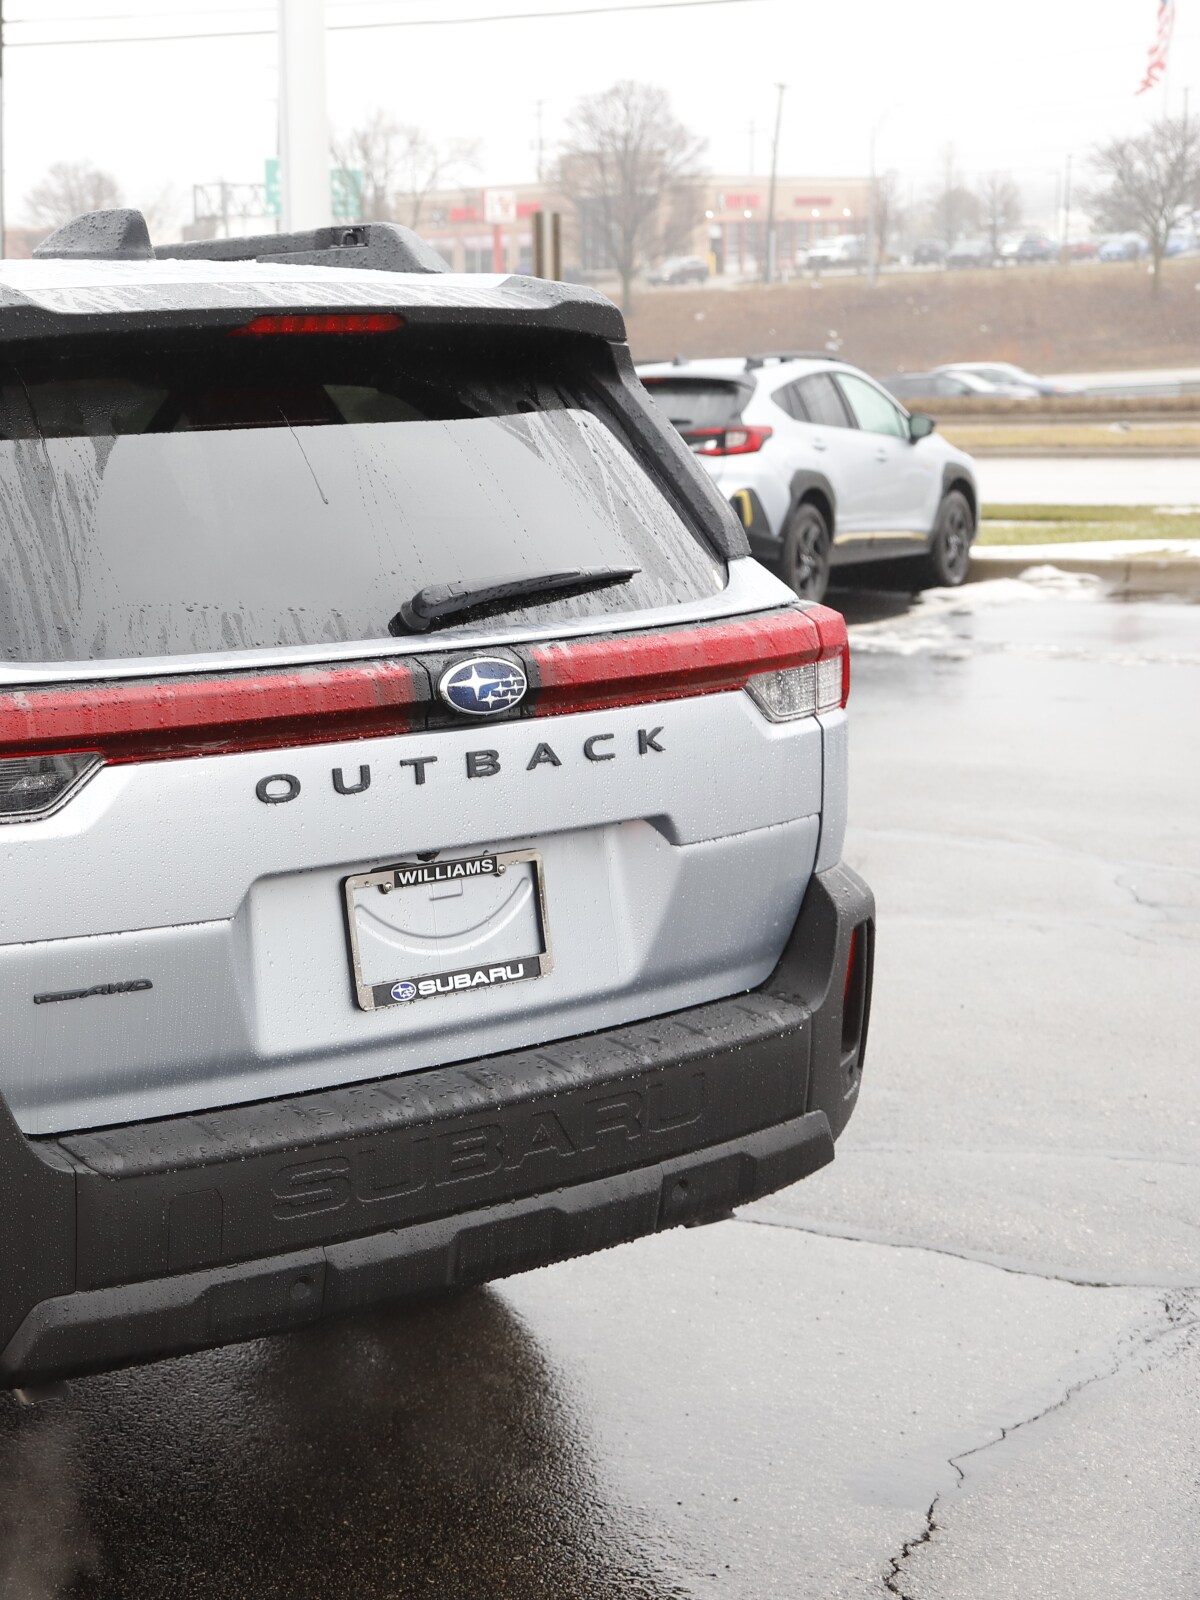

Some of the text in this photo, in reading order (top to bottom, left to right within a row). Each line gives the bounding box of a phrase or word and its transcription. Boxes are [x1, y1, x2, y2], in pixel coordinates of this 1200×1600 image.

[255, 726, 666, 804] OUTBACK
[398, 858, 494, 885] WILLIAMS
[417, 963, 524, 995] SUBARU
[273, 1070, 702, 1220] SUBARU
